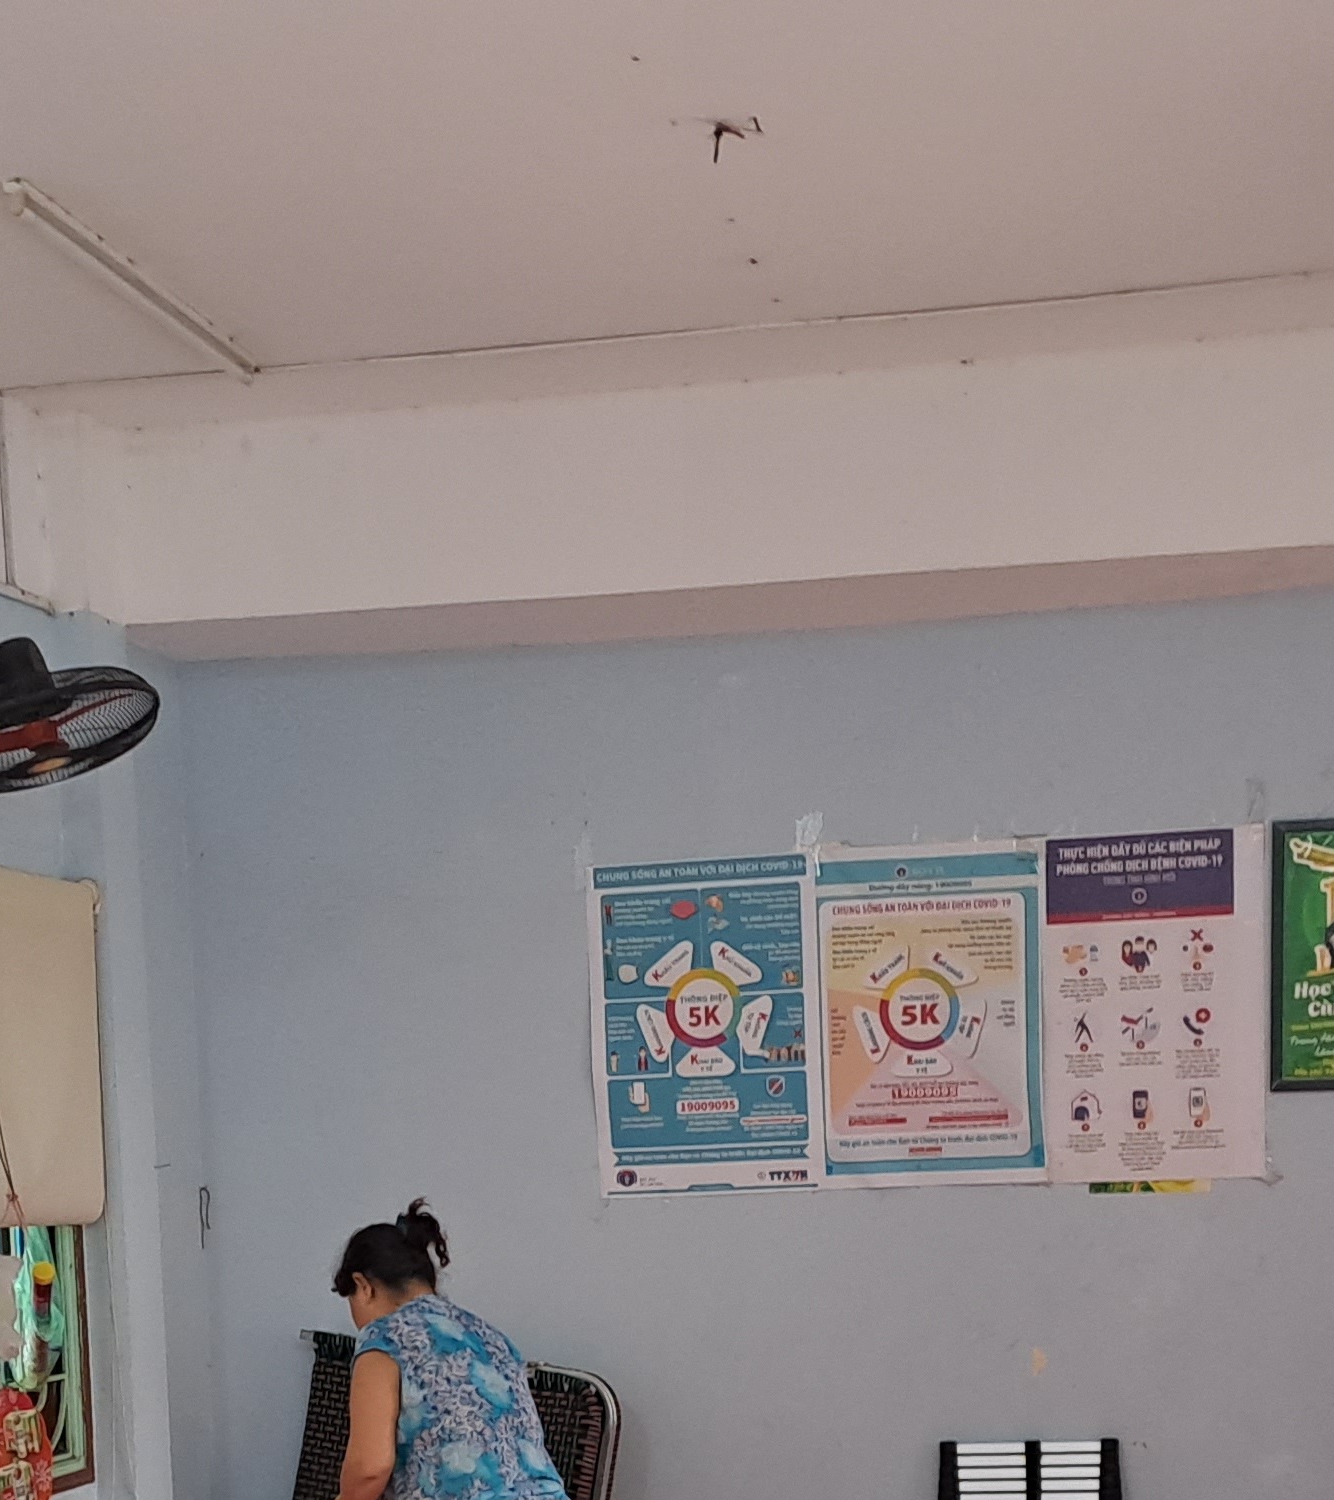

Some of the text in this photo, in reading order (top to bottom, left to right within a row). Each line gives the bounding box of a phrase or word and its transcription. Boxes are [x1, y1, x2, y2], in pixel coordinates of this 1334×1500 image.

[1059, 846, 1085, 861] THỰC
[1087, 844, 1110, 859] HIỆN
[1148, 840, 1168, 854] CÁC
[1169, 838, 1191, 853] BIỆN
[1194, 836, 1221, 850] PHÁP
[1056, 861, 1089, 876] PHÒNG
[1091, 858, 1123, 874] CHỐNG
[1150, 856, 1176, 872] BỆNH
[1178, 853, 1223, 868] COVID-19
[832, 904, 862, 916] CHUNG
[1294, 980, 1332, 1000] Học
[688, 1006, 721, 1027] 5K
[900, 1003, 940, 1026] 5K
[680, 1102, 736, 1113] 19009095
